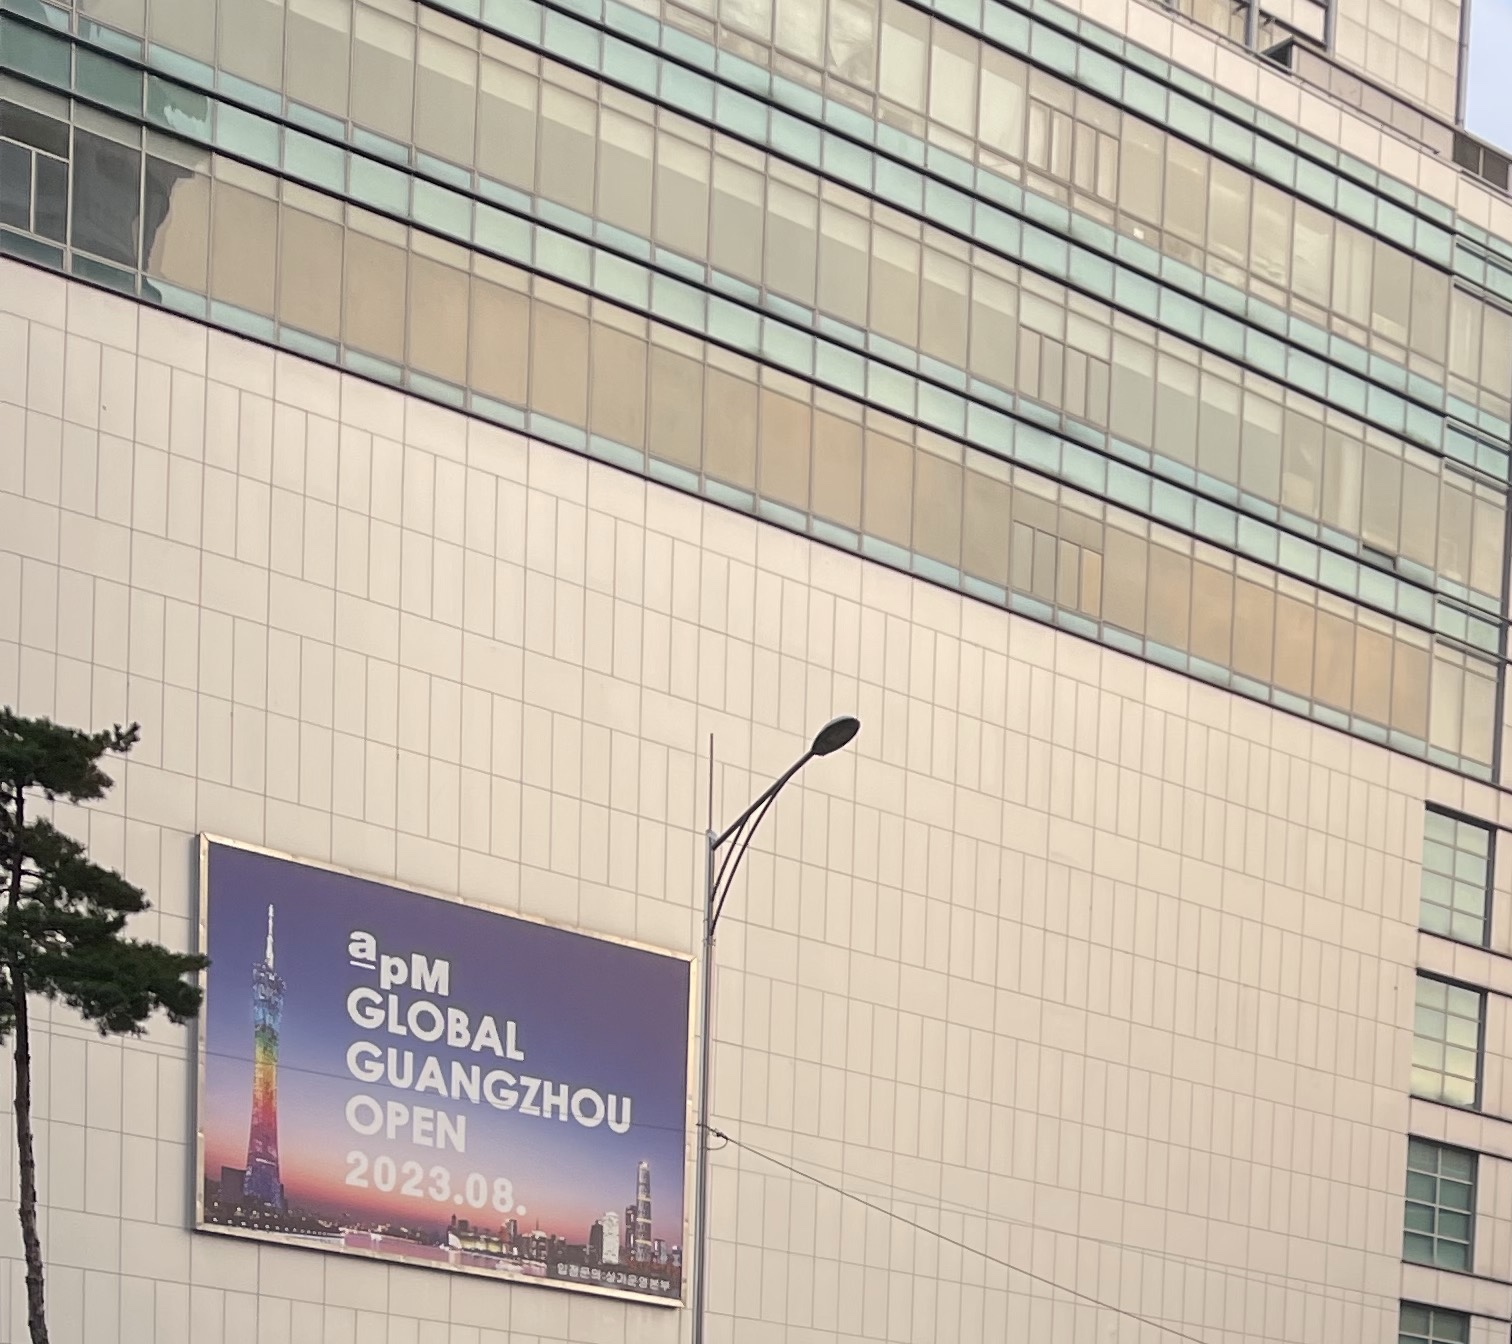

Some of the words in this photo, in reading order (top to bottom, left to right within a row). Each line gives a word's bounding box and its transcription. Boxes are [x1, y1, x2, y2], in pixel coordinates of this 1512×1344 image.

[348, 930, 450, 996] apM
[347, 987, 525, 1061] GLOBAL
[346, 1041, 632, 1134] GUANGZHOU
[345, 1095, 467, 1153] OPEN
[345, 1150, 527, 1216] 2023.08.
